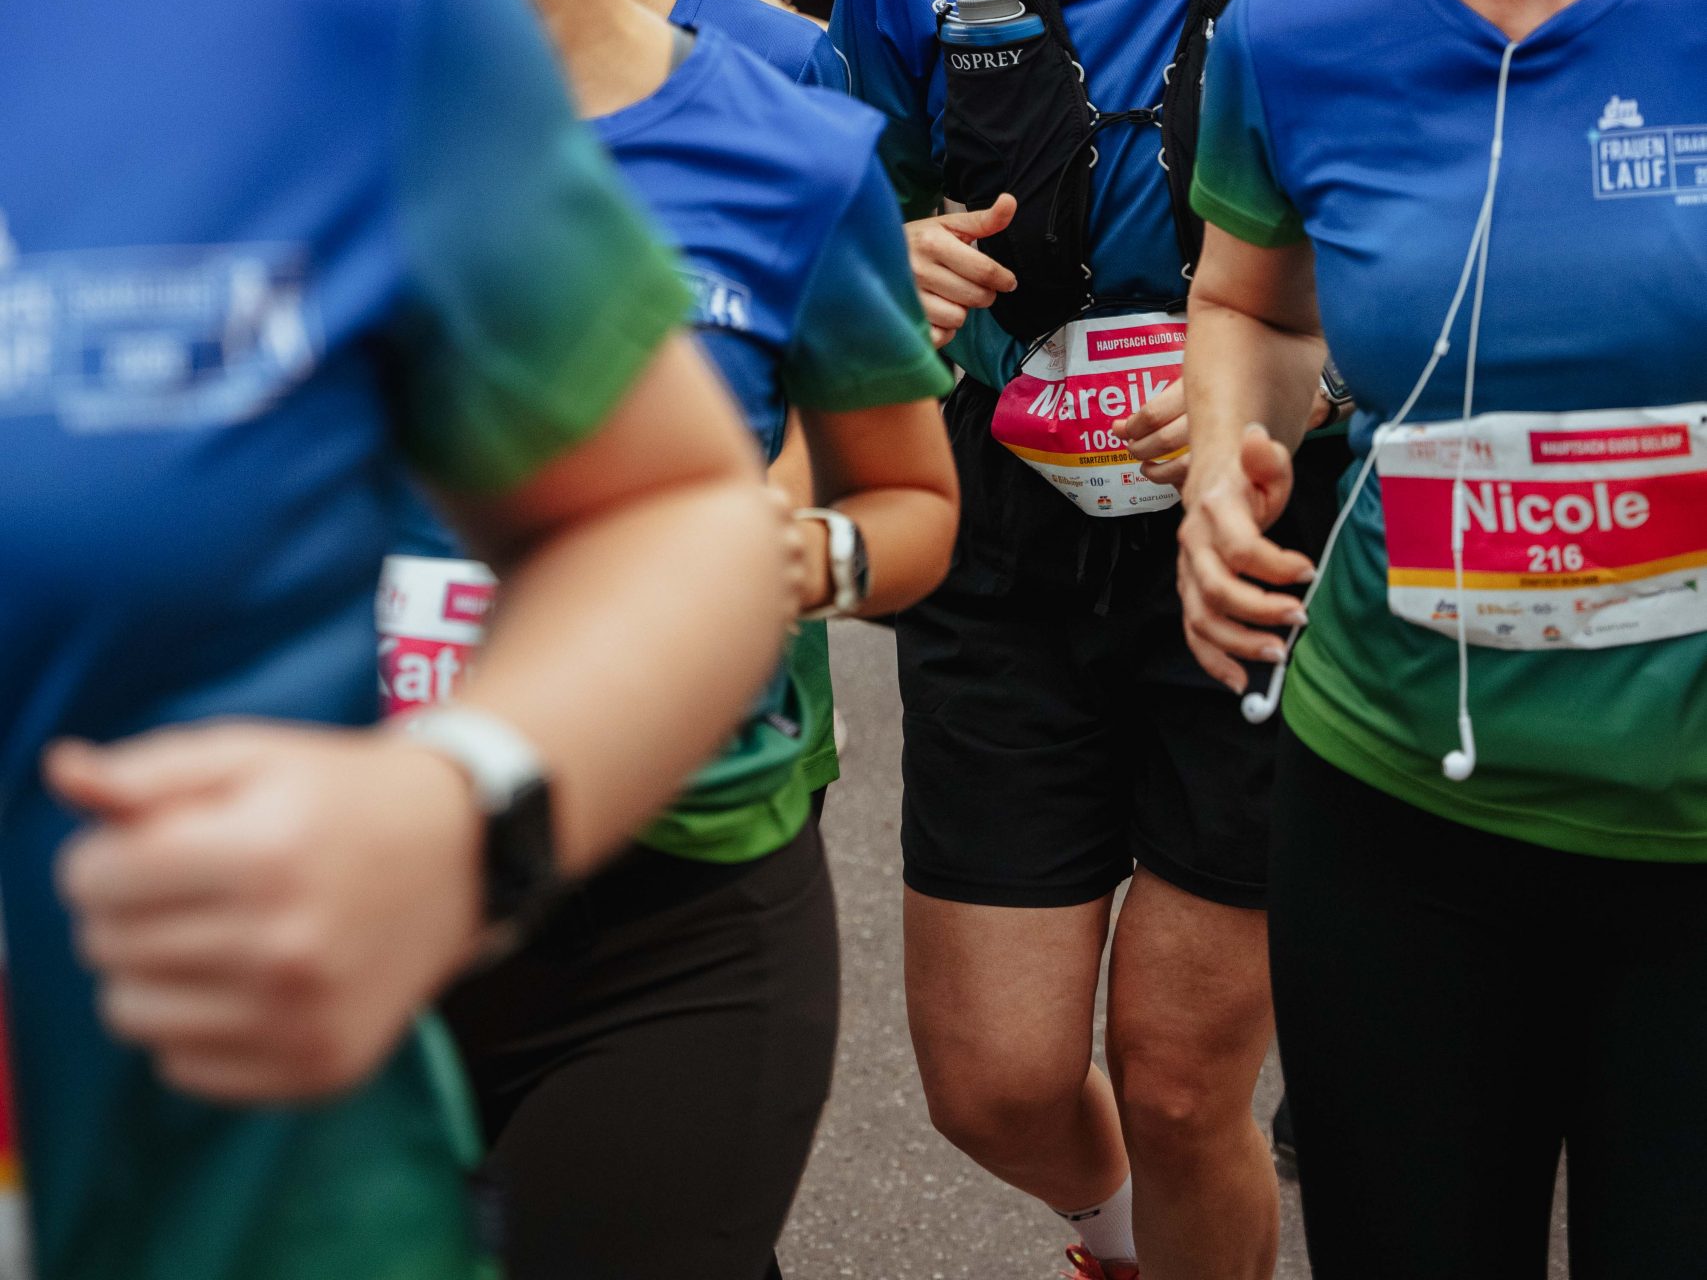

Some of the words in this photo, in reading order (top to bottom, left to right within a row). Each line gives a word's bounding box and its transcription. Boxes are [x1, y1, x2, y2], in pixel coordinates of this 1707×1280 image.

[951, 49, 1024, 70] OSPREY
[1601, 158, 1665, 190] LAUF
[1096, 335, 1147, 352] HAUPTSACH
[1148, 332, 1172, 345] GUDD
[1173, 332, 1187, 342] GEL
[1027, 371, 1169, 421] Mareik
[1079, 429, 1128, 451] 108
[1079, 455, 1110, 465] STARTZEIT
[1457, 481, 1650, 534] Nicole
[1527, 543, 1584, 571] 216
